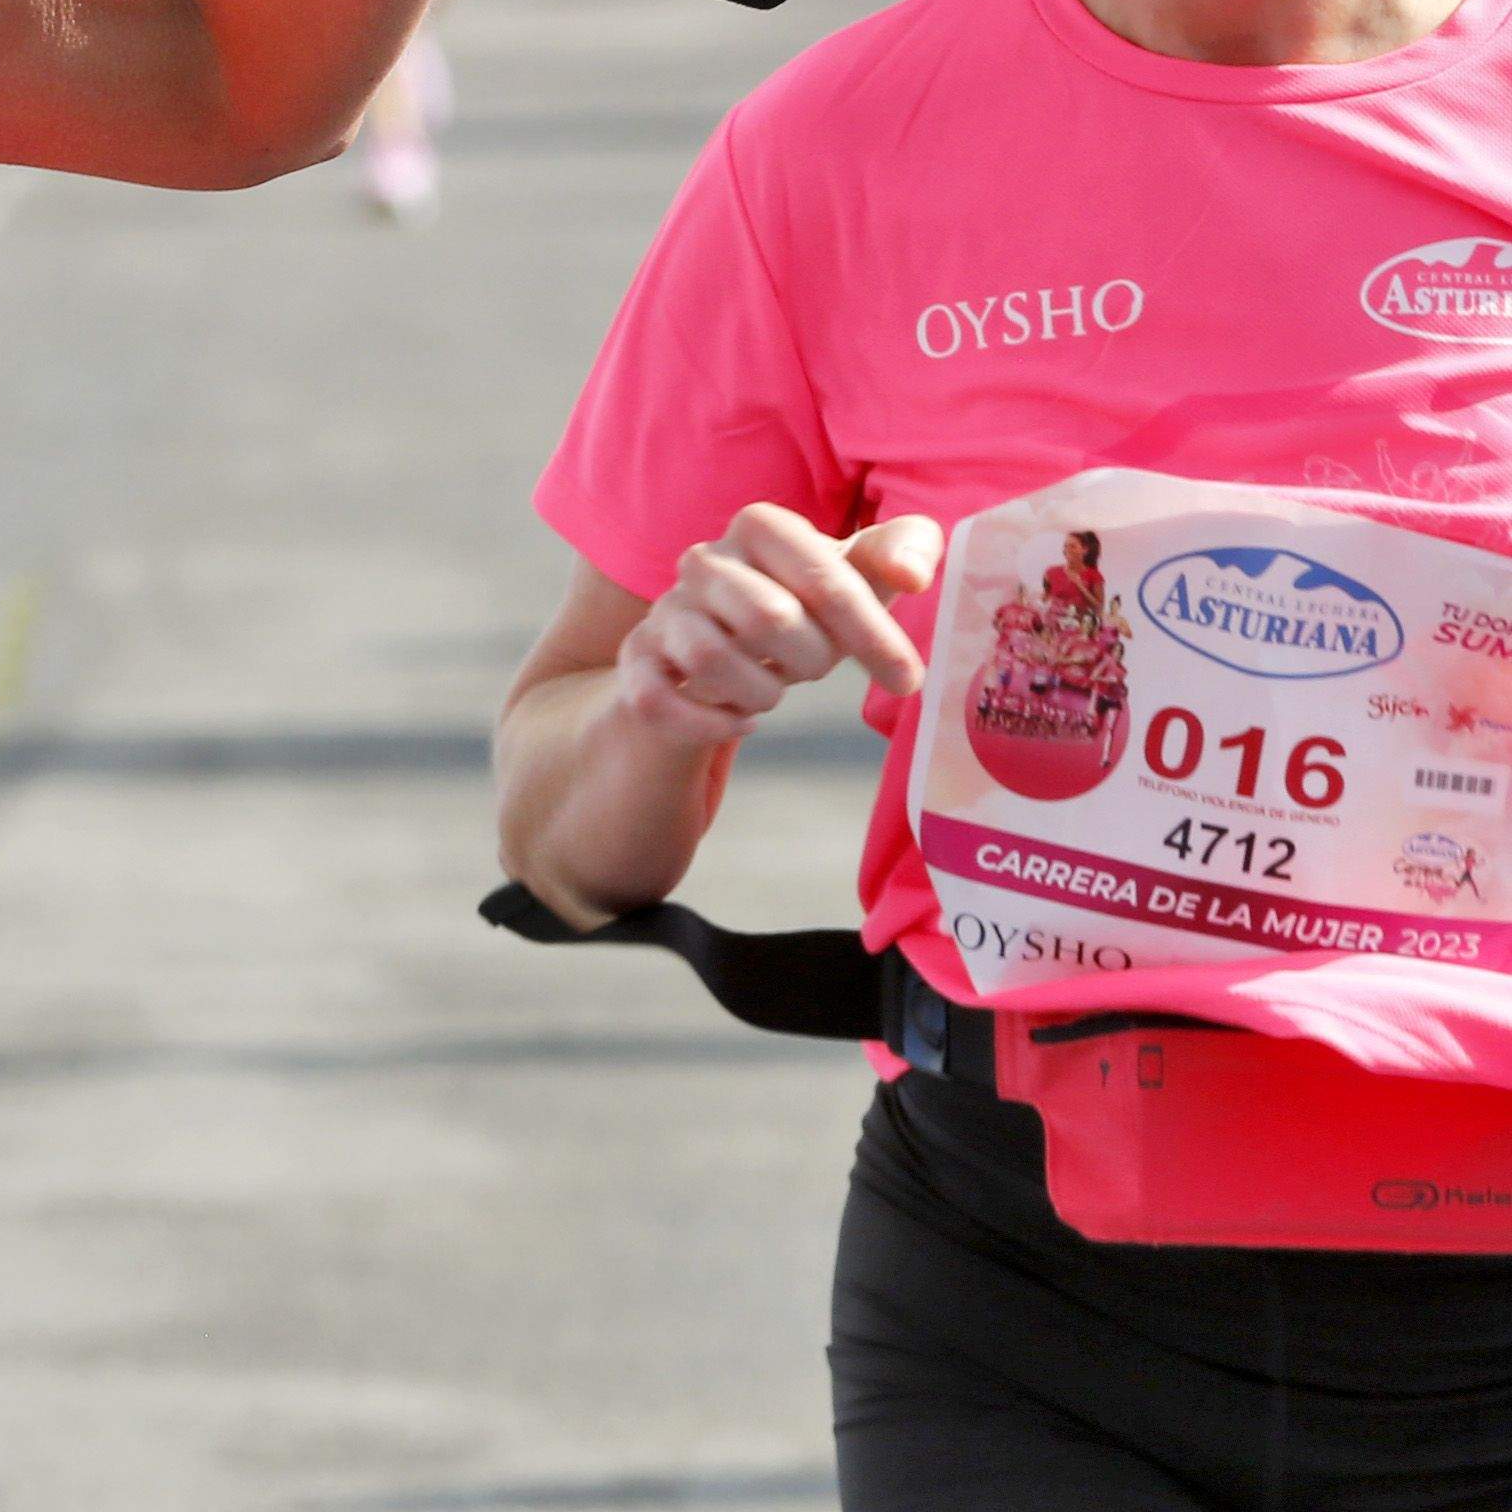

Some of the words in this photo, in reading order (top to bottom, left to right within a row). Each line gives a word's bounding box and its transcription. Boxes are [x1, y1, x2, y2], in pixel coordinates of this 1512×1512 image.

[916, 278, 1145, 360] OYSHO
[1379, 273, 1512, 317] ASTURI
[1157, 571, 1379, 659] ASTURIANA
[1433, 622, 1512, 659] SUM
[1144, 706, 1346, 809] 016
[1163, 817, 1297, 881] 4712
[976, 843, 1138, 907] CARRERA
[1147, 885, 1201, 920] DE
[1206, 898, 1252, 931] LA
[1261, 908, 1384, 952] MUJER
[1397, 928, 1482, 960] 2023
[953, 912, 1132, 971] OYSHO
